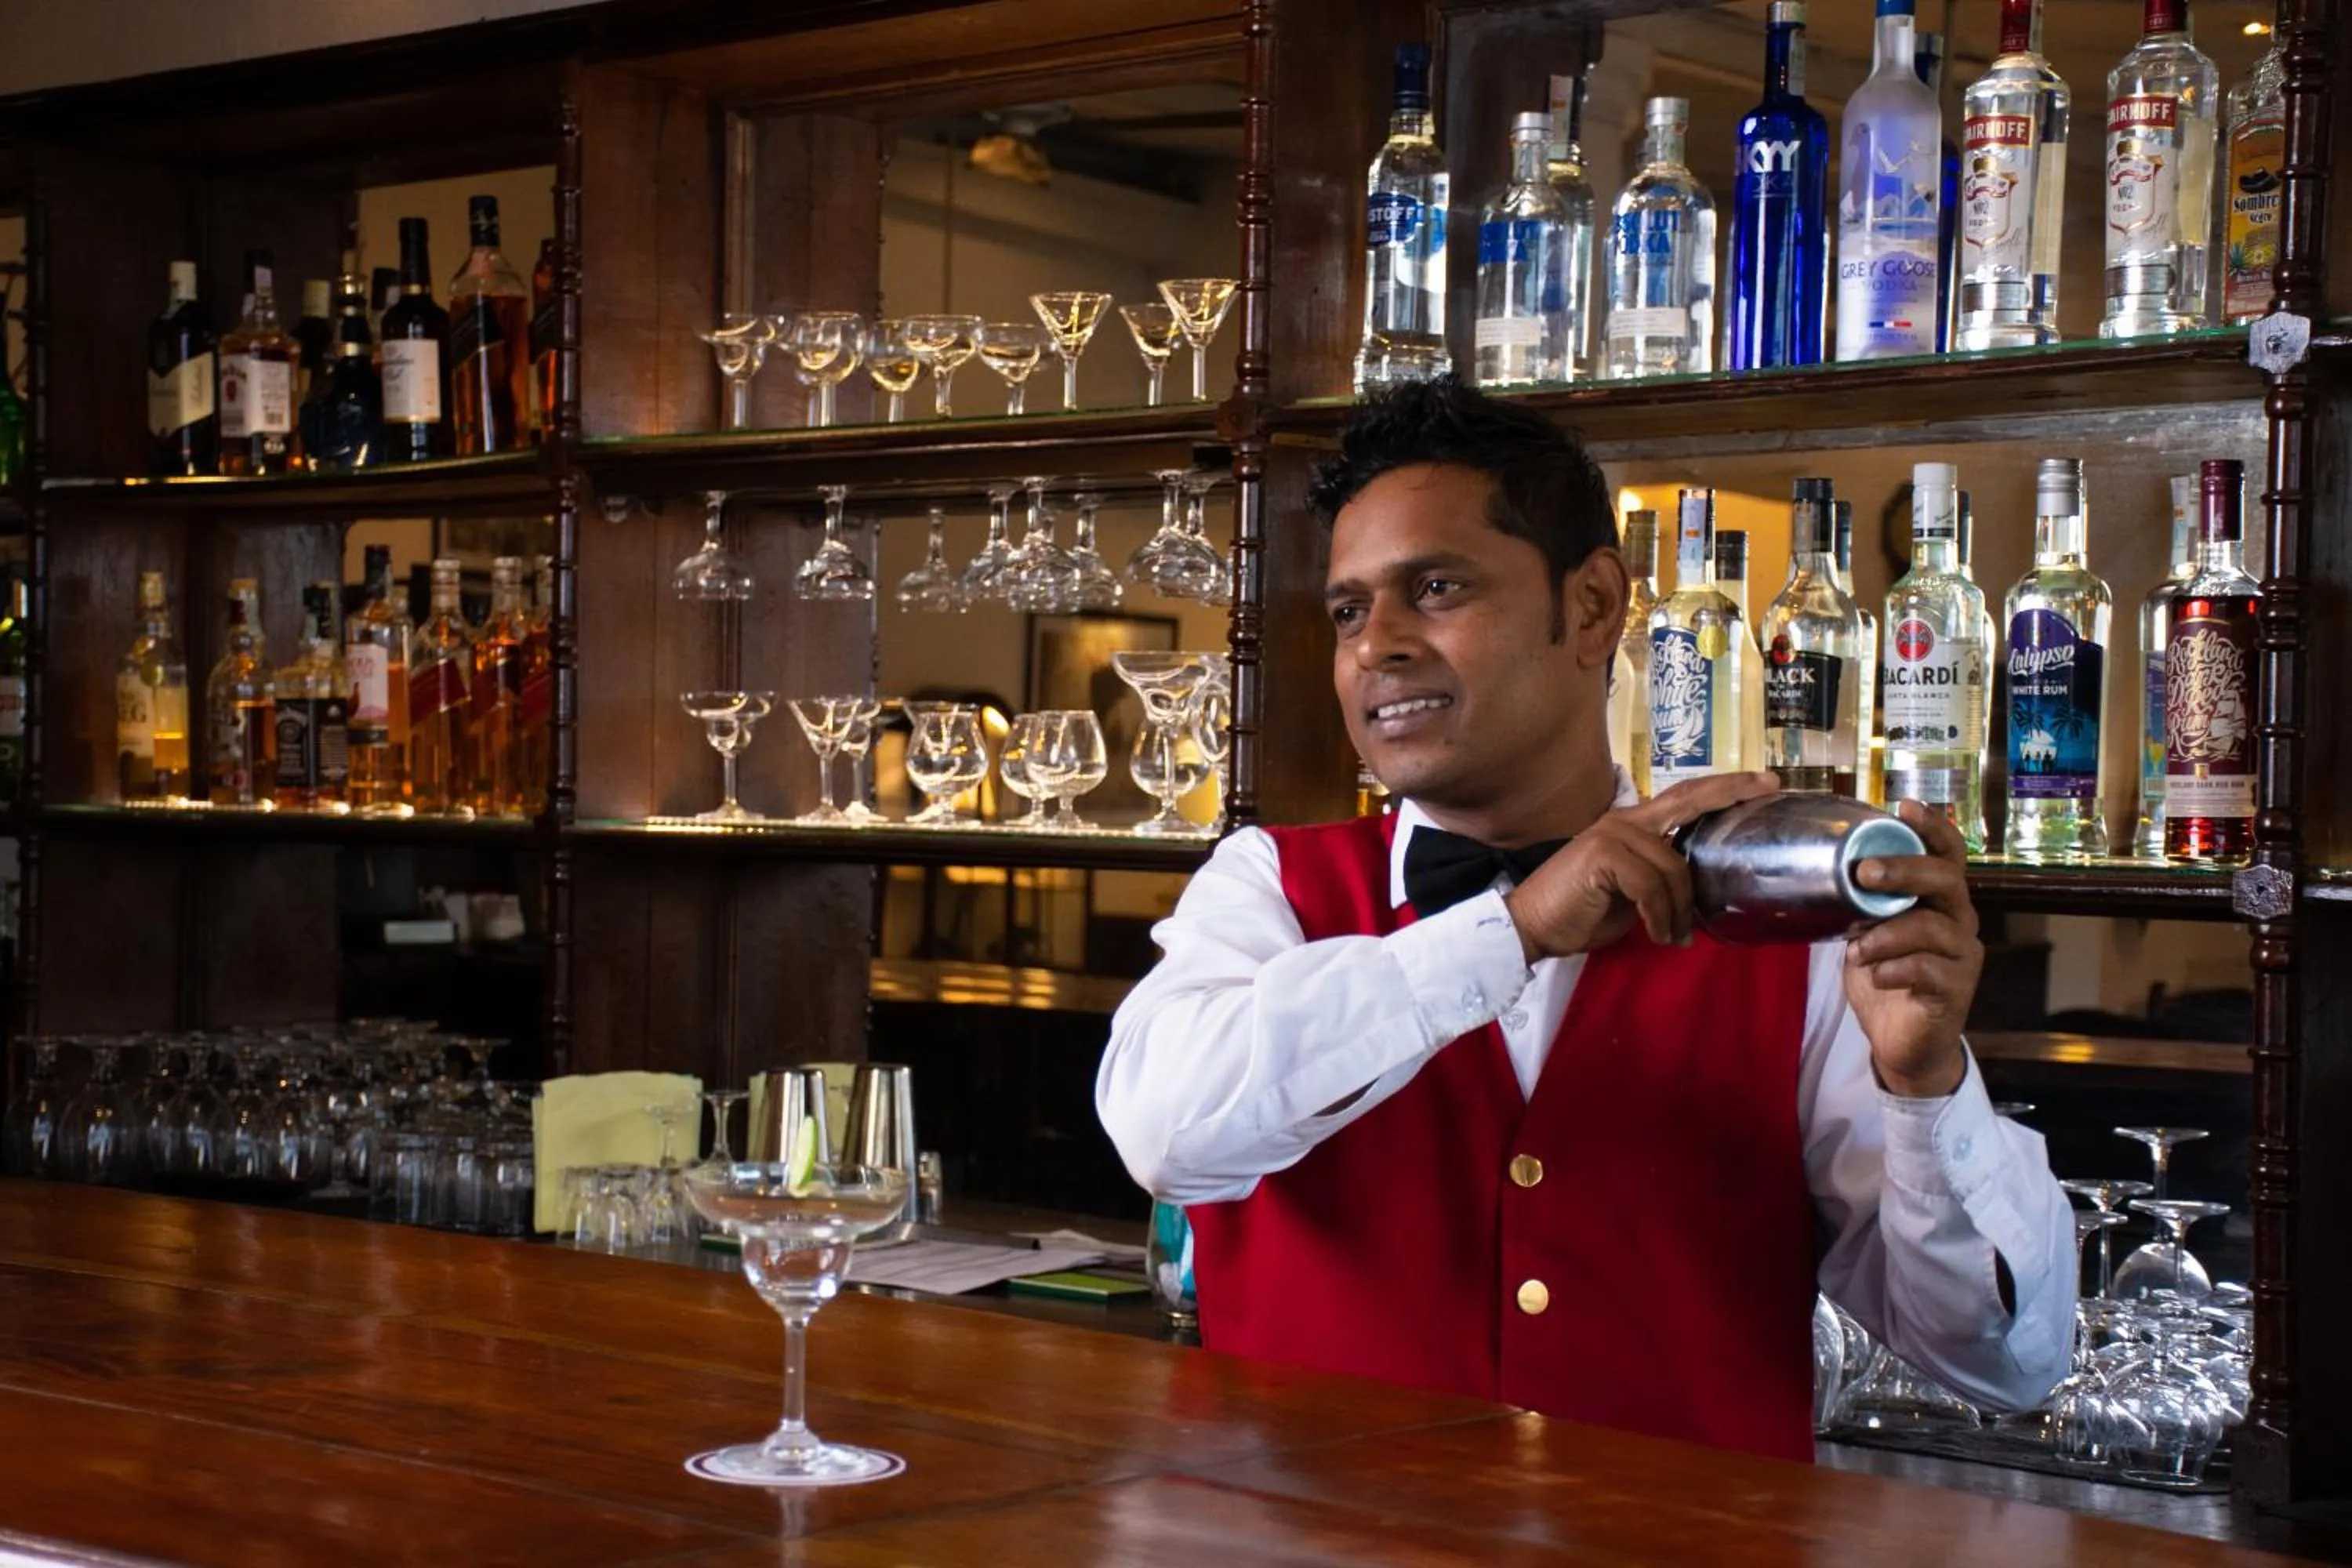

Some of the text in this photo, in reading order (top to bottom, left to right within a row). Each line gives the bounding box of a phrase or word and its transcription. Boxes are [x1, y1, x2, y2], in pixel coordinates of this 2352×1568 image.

[2107, 101, 2171, 125] MIRNOFF
[1964, 121, 2027, 140] MIRNOFF
[2234, 195, 2282, 212] Sombre
[1367, 205, 1417, 223] STOFF
[1842, 259, 1936, 279] GREY GOOSE
[1765, 667, 1816, 684] LACK
[1883, 660, 1959, 685] BACARDÍ
[2042, 684, 2068, 695] RUM
